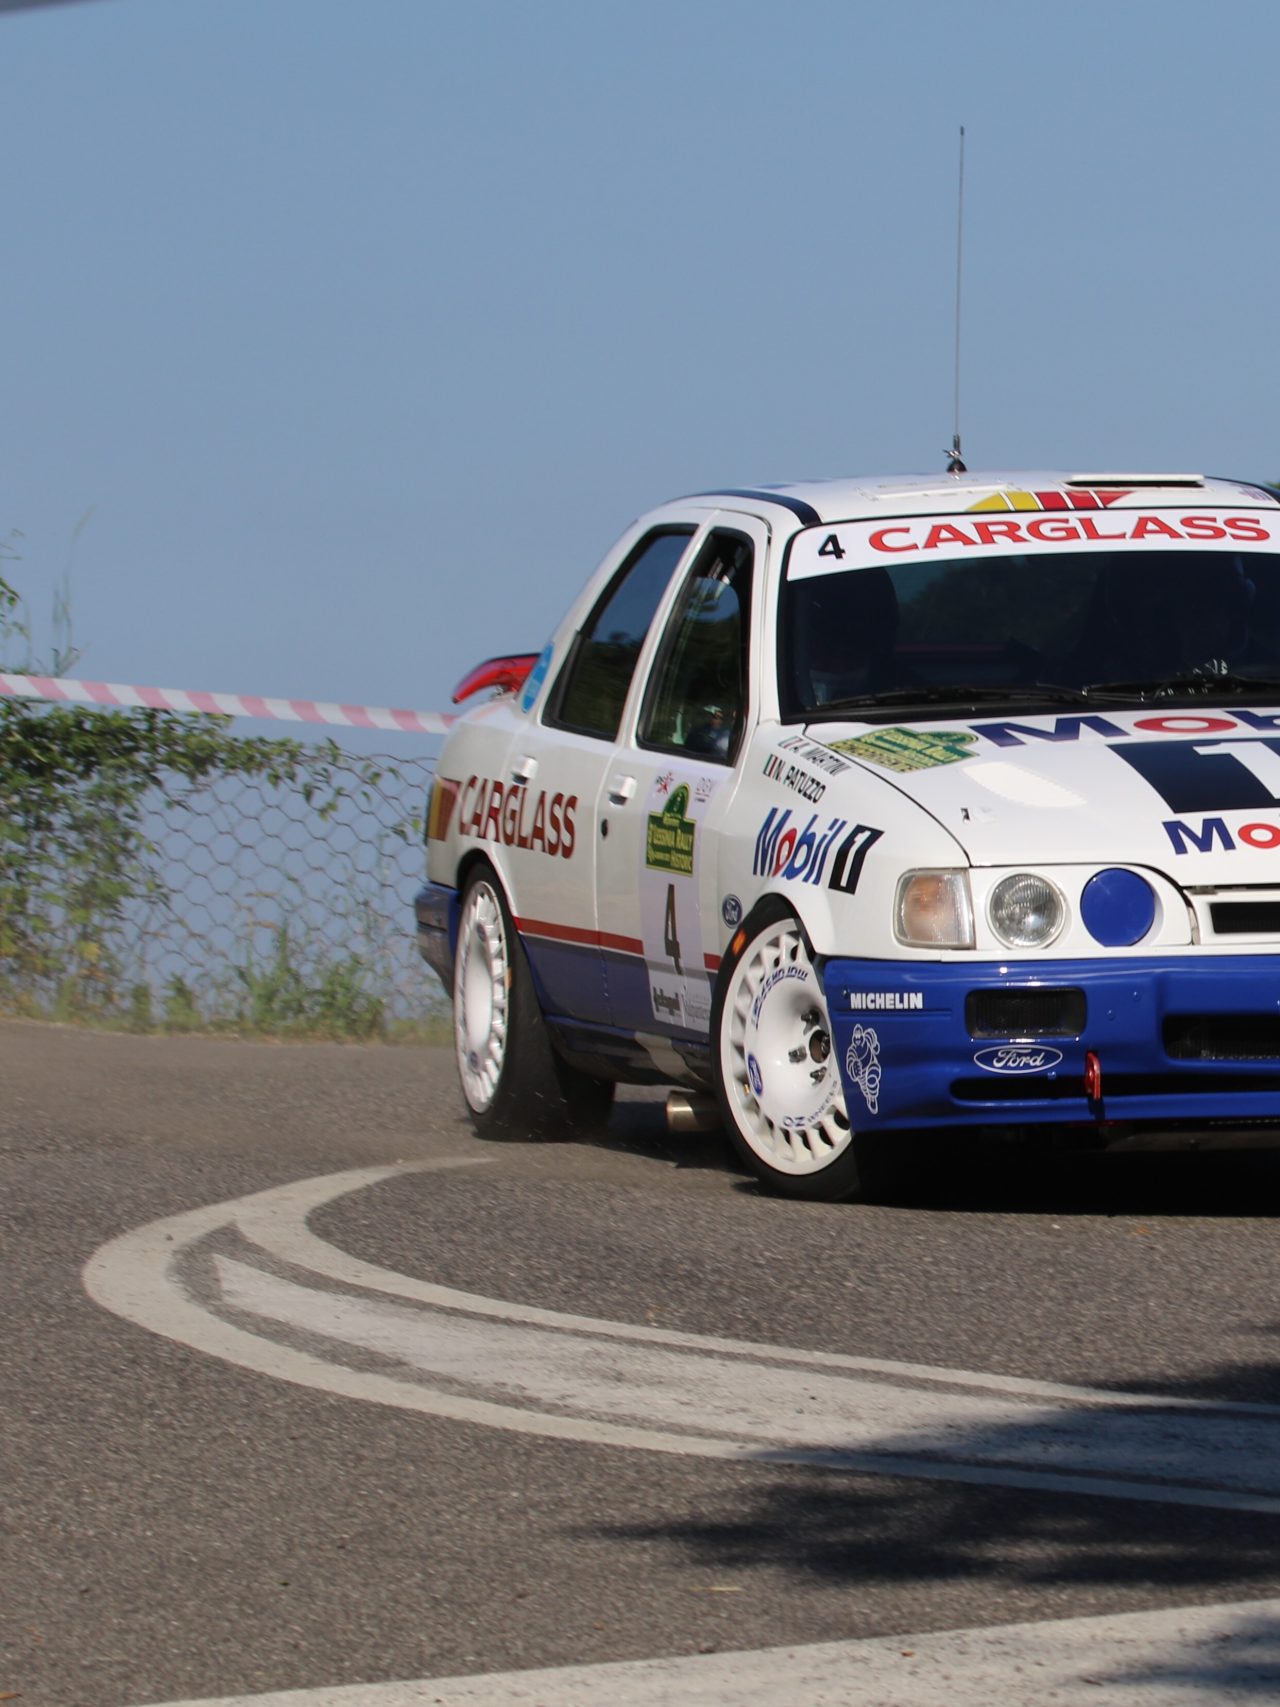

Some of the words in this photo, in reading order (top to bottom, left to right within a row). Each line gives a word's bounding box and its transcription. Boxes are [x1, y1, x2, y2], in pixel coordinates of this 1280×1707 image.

[818, 534, 845, 561] 4
[868, 515, 1271, 554] CARGLASS
[783, 765, 826, 804] PATUZZO
[458, 774, 579, 860] CARGLASS
[753, 806, 848, 886] Mobil
[664, 883, 684, 976] 4
[850, 992, 924, 1010] MICHELIN
[992, 1048, 1046, 1068] Ford
